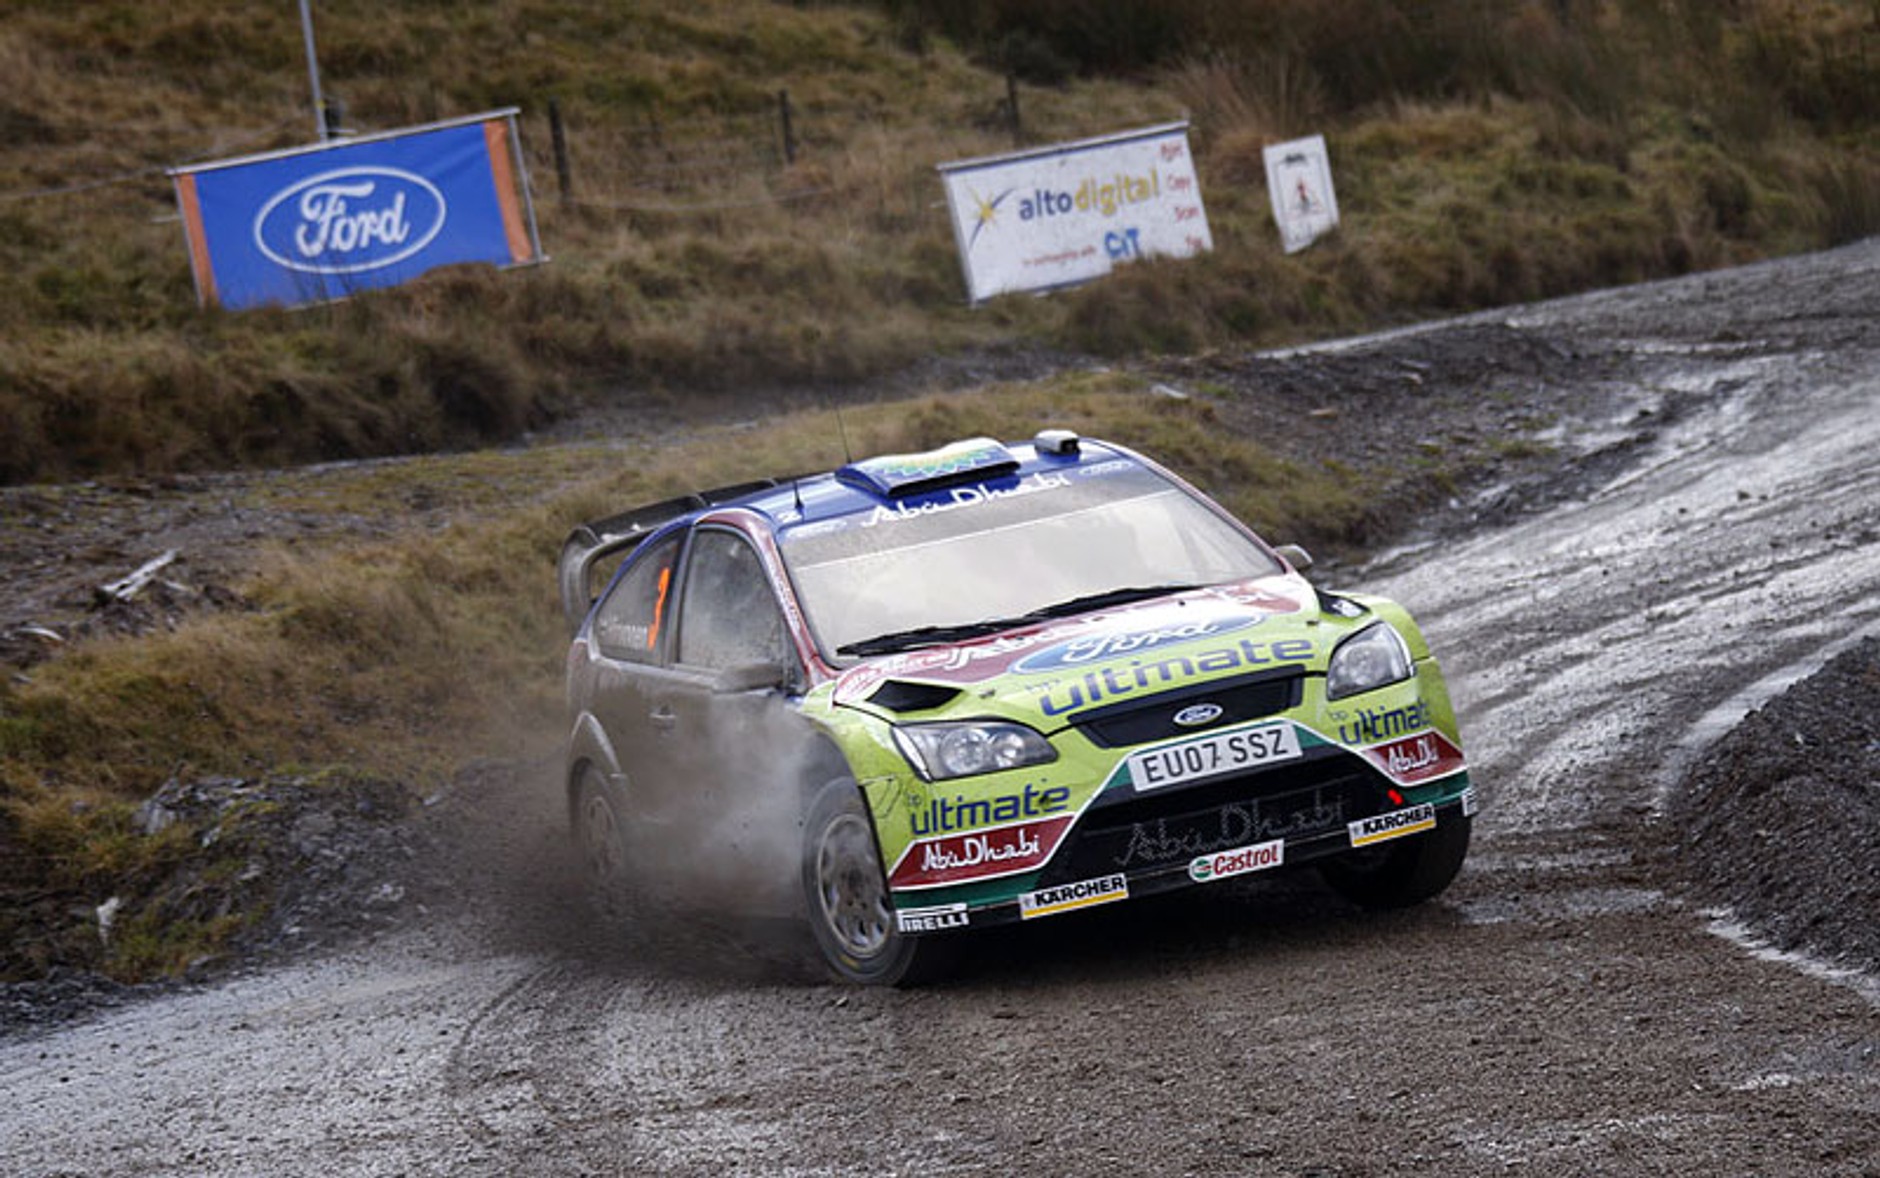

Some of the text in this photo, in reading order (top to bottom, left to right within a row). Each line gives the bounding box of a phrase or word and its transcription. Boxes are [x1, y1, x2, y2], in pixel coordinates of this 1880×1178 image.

[295, 182, 410, 257] Ford
[949, 472, 1072, 509] Dhabi
[1061, 619, 1221, 663] Ford
[1039, 639, 1315, 716] ultimate
[1339, 697, 1431, 745] ultimat
[1141, 729, 1288, 783] EU07 SSZ
[911, 784, 1070, 836] ultimate
[1113, 788, 1345, 867] Abu Dhabi
[921, 828, 1040, 872] Abu Dhabi
[1213, 844, 1278, 876] Castrol
